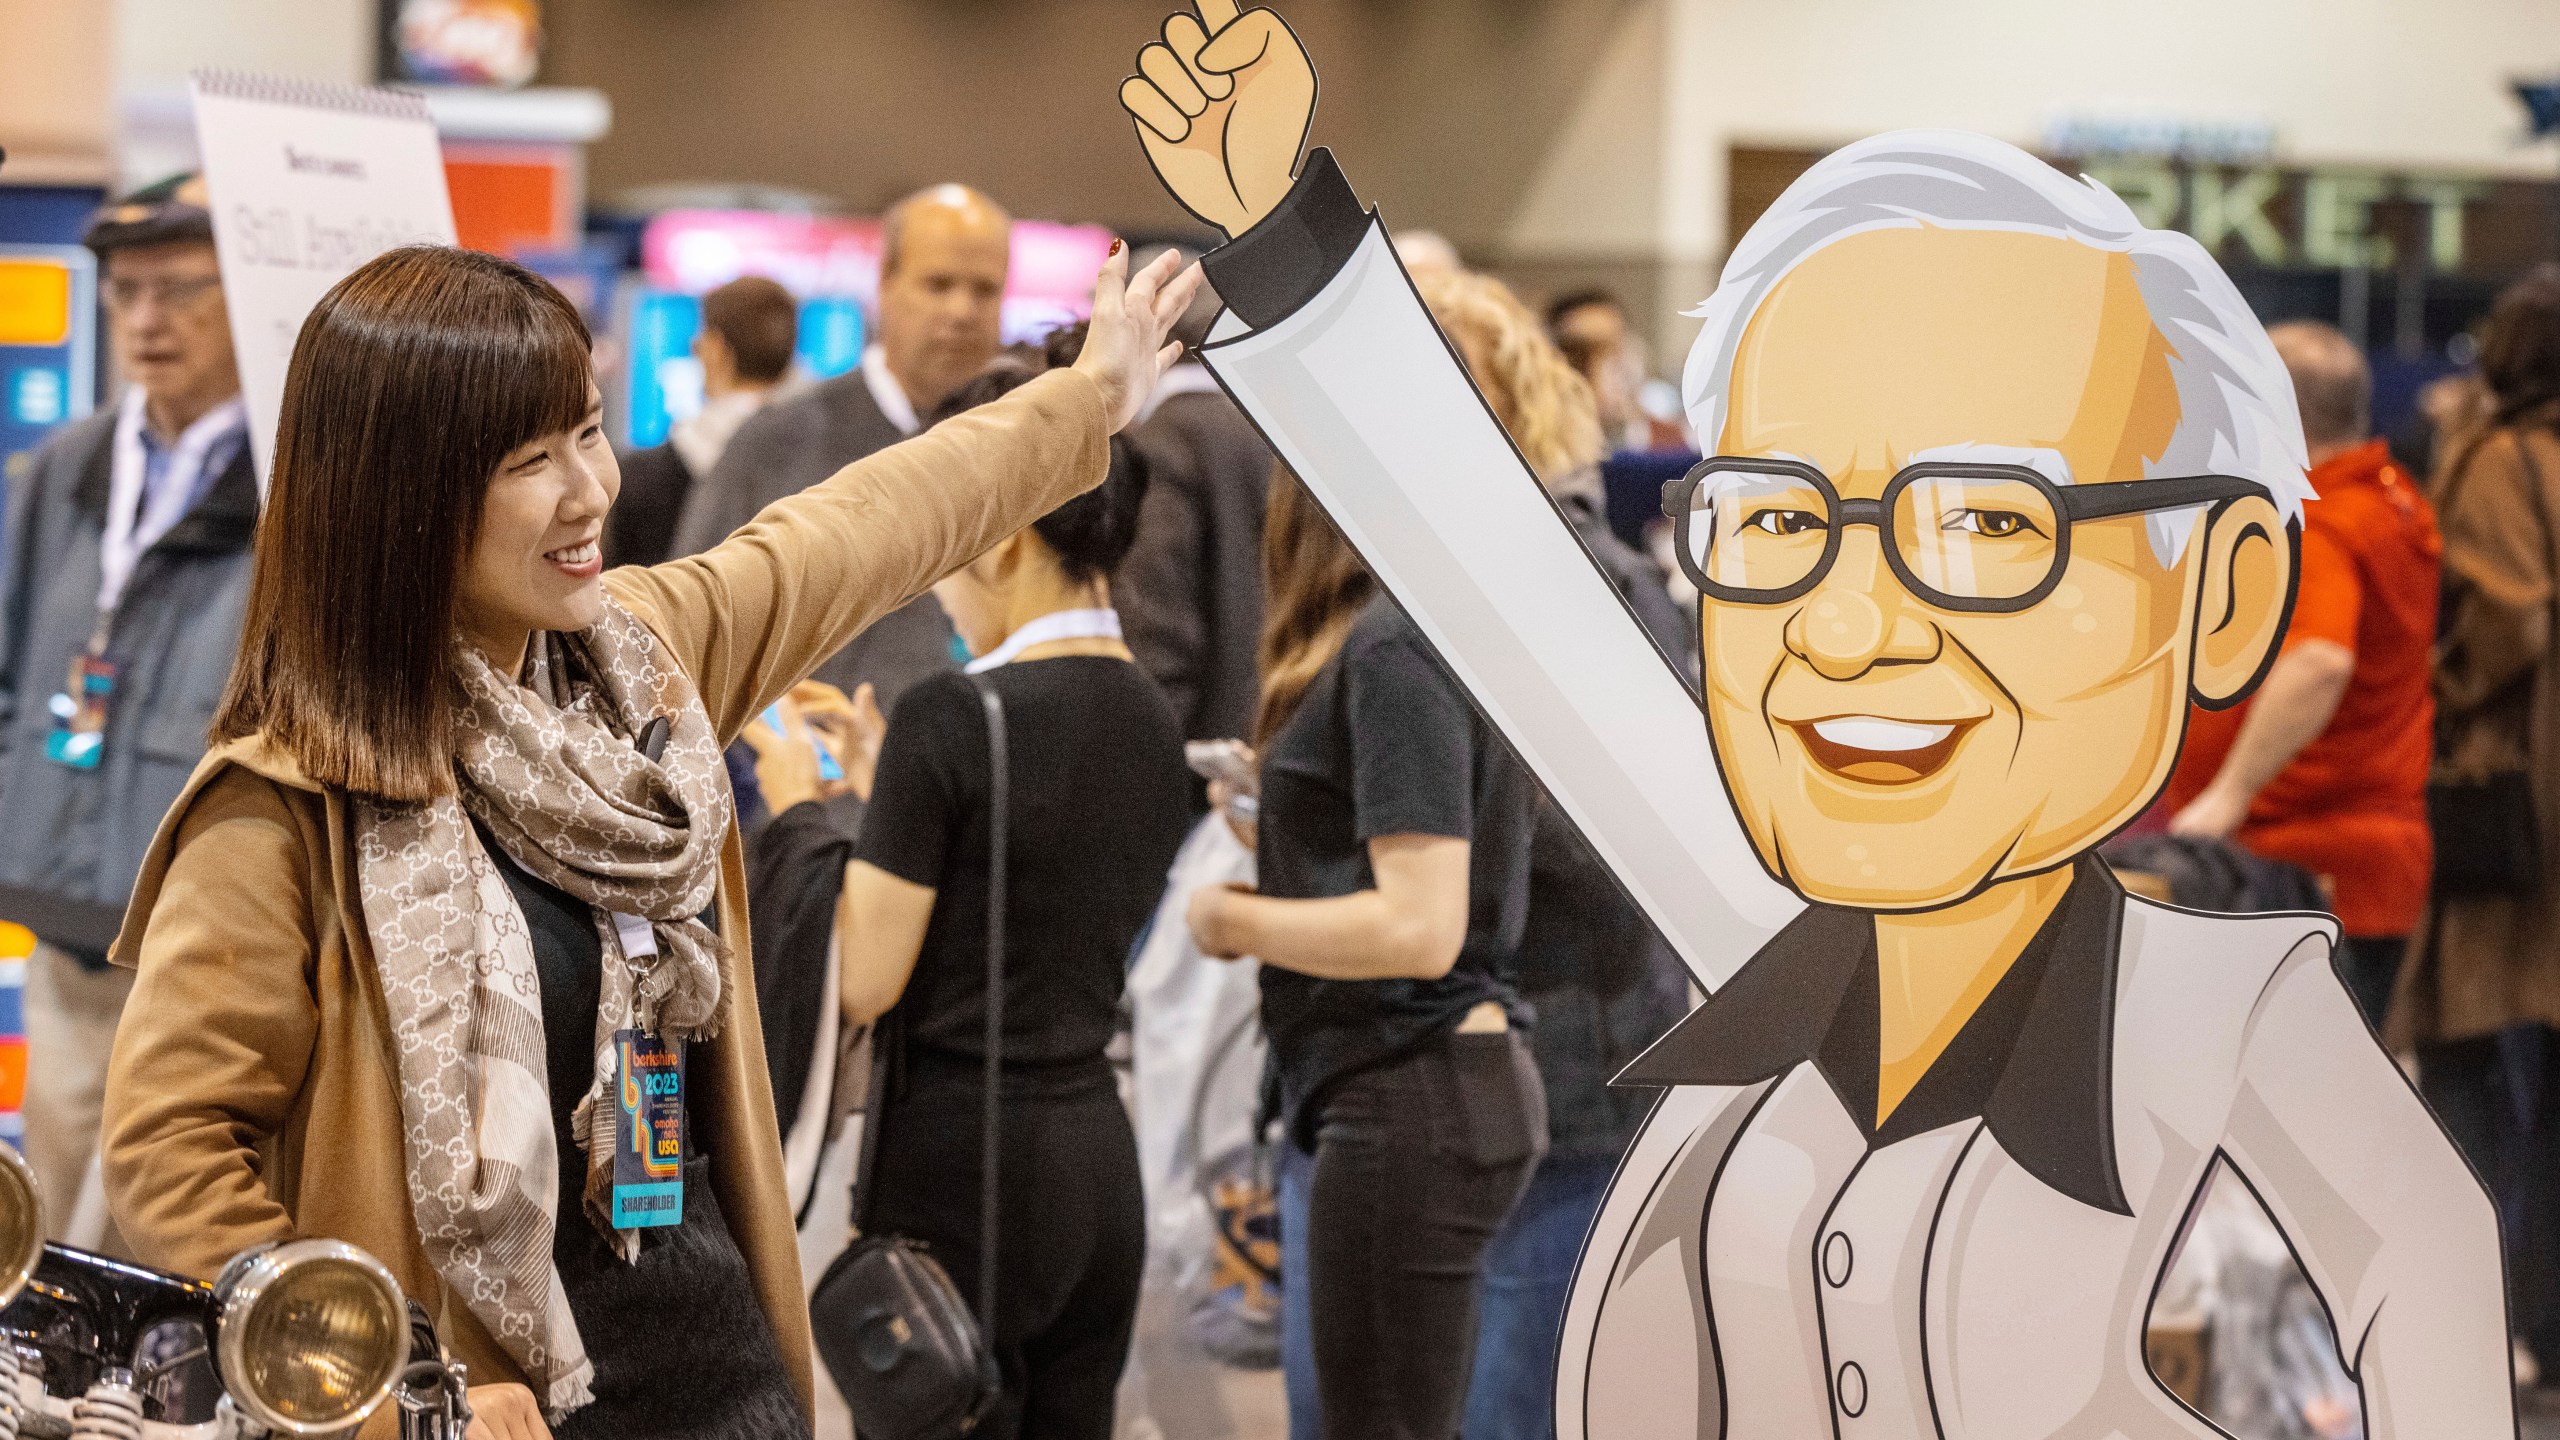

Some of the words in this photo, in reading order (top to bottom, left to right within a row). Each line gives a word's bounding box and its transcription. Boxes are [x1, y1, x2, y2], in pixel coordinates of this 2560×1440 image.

[633, 1050, 678, 1067] berkshire
[645, 1073, 679, 1096] 2023
[621, 1194, 676, 1213] SHAREHOLDER
